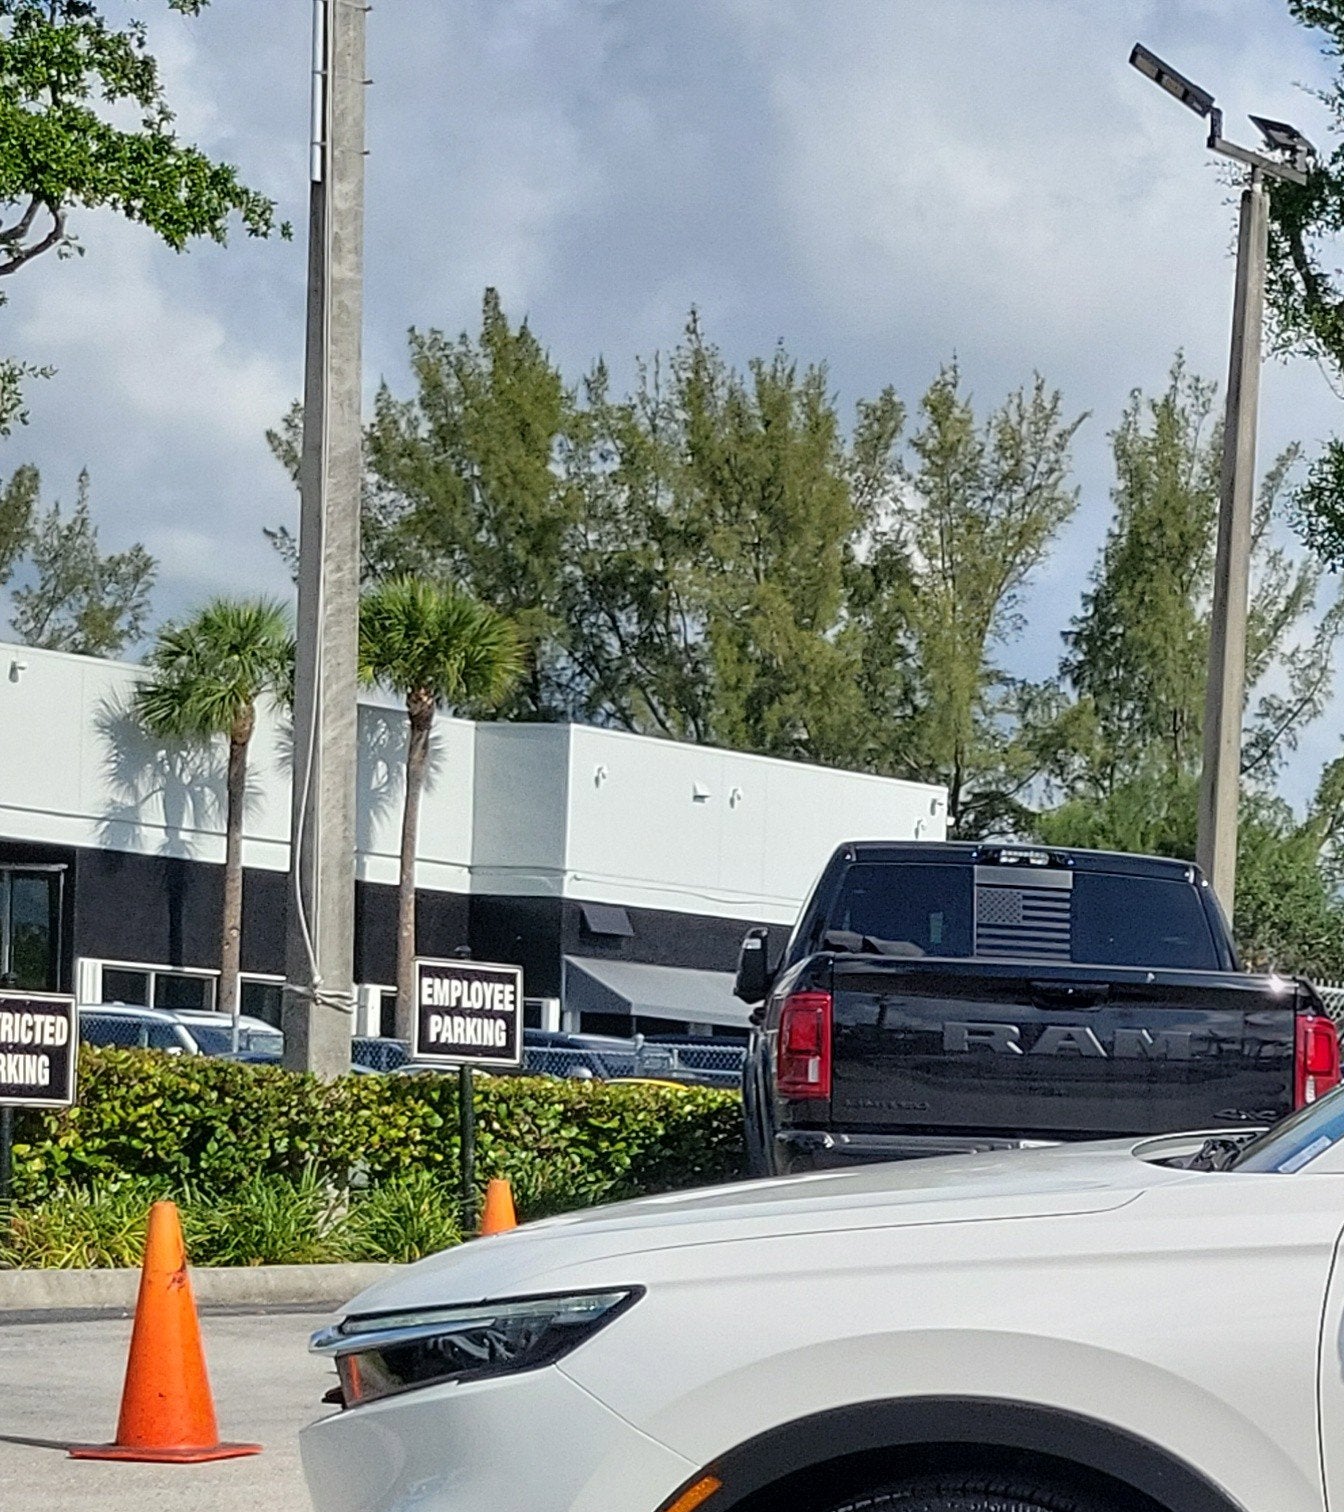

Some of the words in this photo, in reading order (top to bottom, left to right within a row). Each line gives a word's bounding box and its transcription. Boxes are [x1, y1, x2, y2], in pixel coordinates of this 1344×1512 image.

[422, 976, 514, 1012] EMPLOYEE
[0, 1012, 68, 1046] RICTED
[429, 1014, 507, 1048] PARKING
[943, 1021, 1191, 1059] RAM
